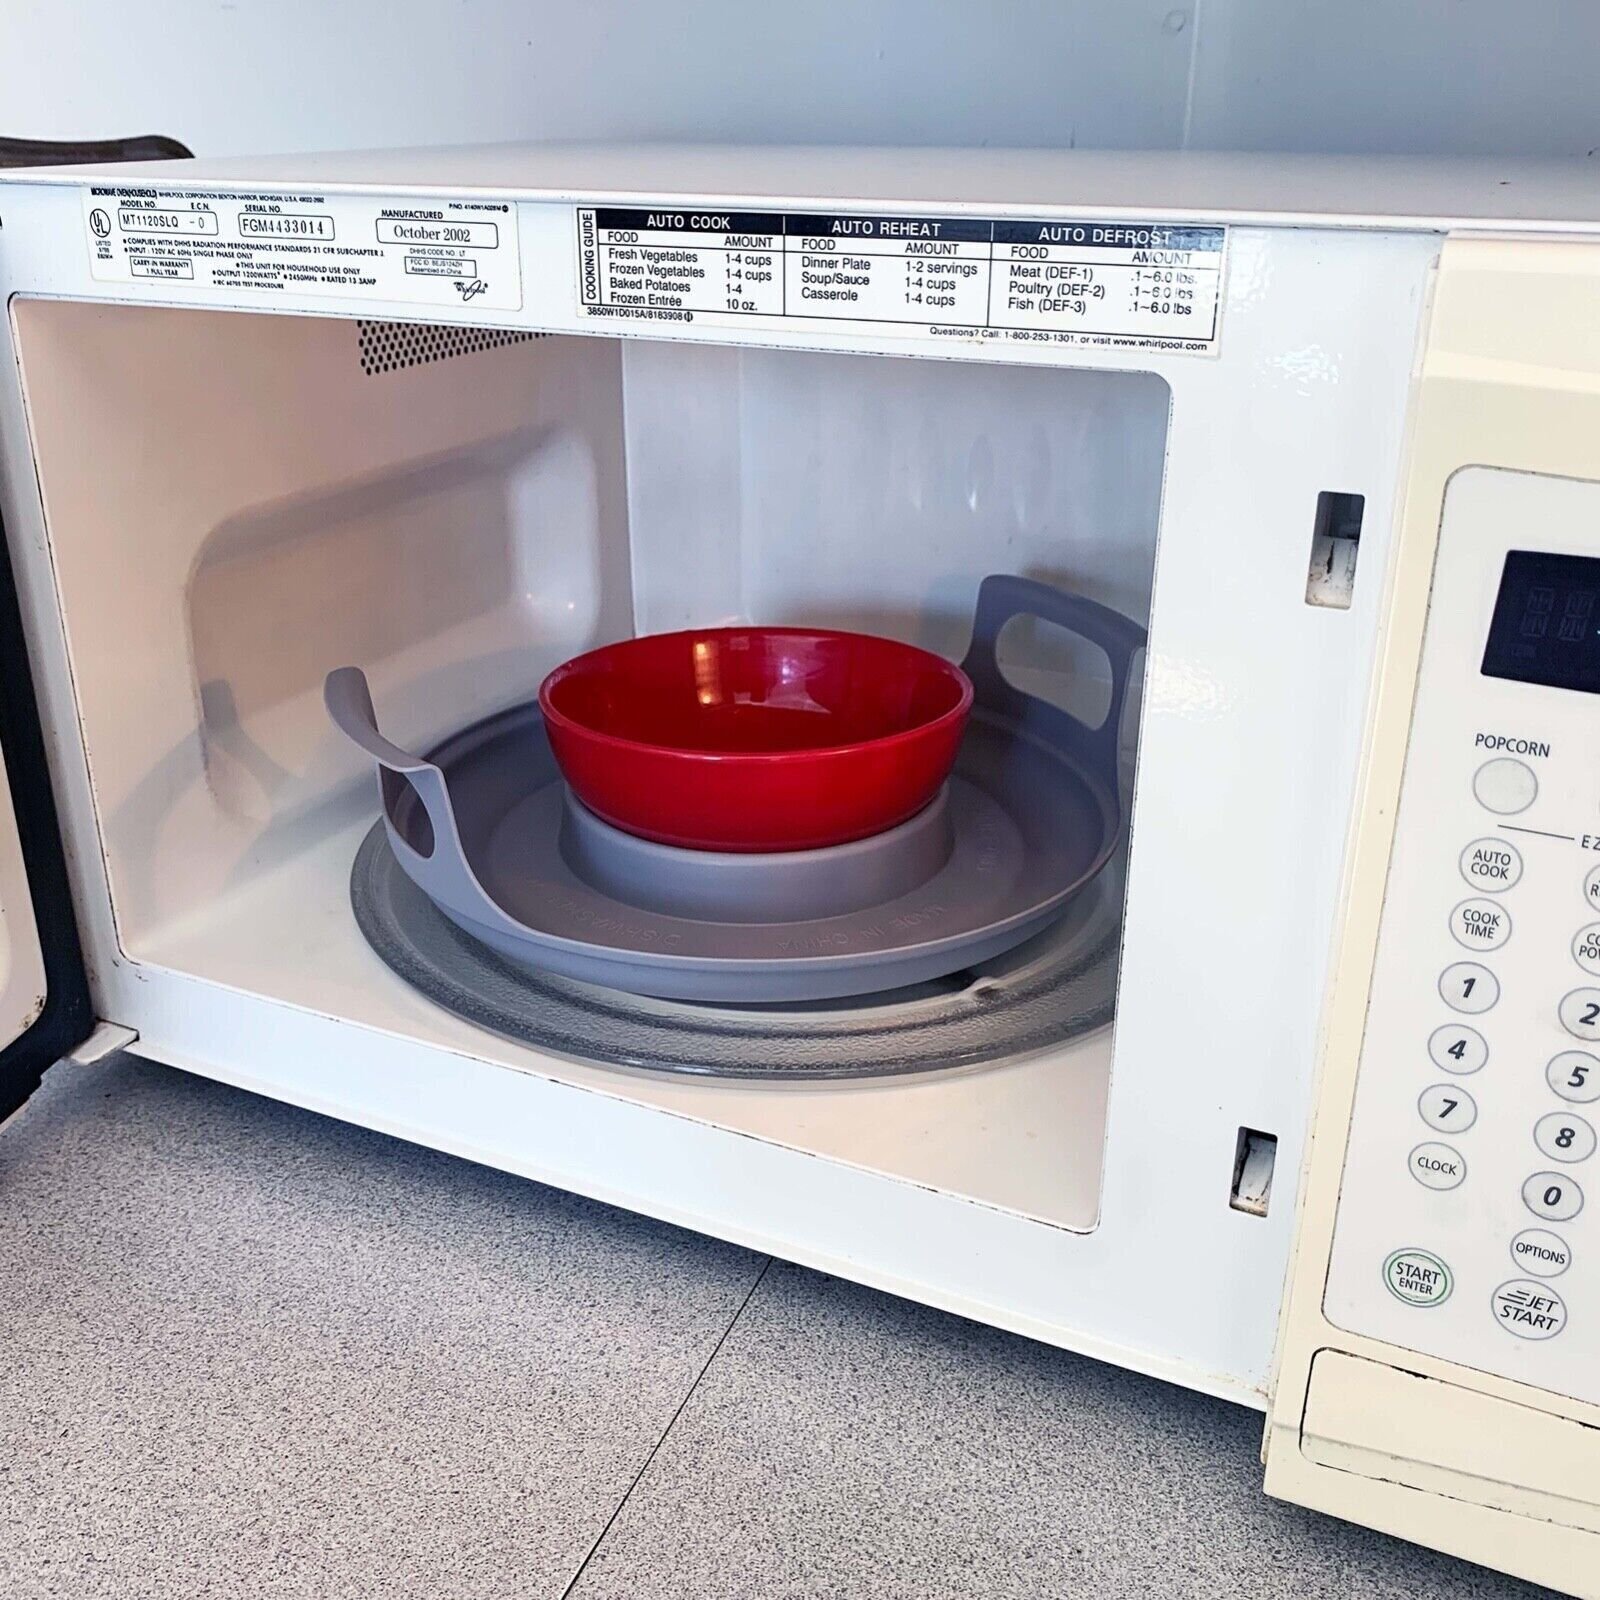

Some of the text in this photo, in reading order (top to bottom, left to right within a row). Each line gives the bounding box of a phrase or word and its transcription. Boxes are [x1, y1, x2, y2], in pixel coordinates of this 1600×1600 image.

[120, 200, 142, 208] MODEL
[245, 204, 267, 212] SERIAL
[122, 214, 178, 228] MT1120SLQ
[381, 210, 443, 219] MANUFACTURED
[647, 214, 731, 230] AUTO COOK
[243, 219, 323, 234] FGM4433014
[394, 225, 470, 242] October 2002
[832, 220, 942, 237] AUTO REHEAT
[607, 231, 639, 243] FOOD
[724, 235, 773, 248] AMOUNT
[801, 238, 836, 251] FOOD
[1038, 227, 1172, 246] AUTO DEFROST
[128, 238, 156, 246] COMPLIES
[227, 242, 272, 251] PERFORMANCE
[274, 244, 311, 253] STANDARDS
[336, 248, 378, 256] SUBCHAPTER
[905, 242, 959, 256] AMOUNT
[1011, 246, 1048, 259] FOOD
[582, 213, 596, 300] COOKING GUIDE
[608, 248, 772, 268] Fresh Vegetables 1-4 cups
[1132, 251, 1193, 265] AMOUNT
[272, 263, 285, 271] FOR
[287, 264, 327, 273] HOUSEHOLD
[329, 266, 340, 274] USE
[343, 267, 361, 275] ONLY
[609, 262, 772, 283] Frozen Vegetables 1-4 cups
[801, 256, 978, 278] Dinner Plate 1-2 servings
[1010, 265, 1041, 278] Meat
[1045, 266, 1093, 282] (DEF-1)
[217, 270, 241, 278] OUTPUT
[326, 276, 347, 284] RATED
[610, 277, 742, 294] Baked Potatoes 1-4
[801, 272, 956, 292] Soup/Sauce 1-4 cups
[801, 287, 955, 308] Casserole 1-4 cups
[1009, 281, 1052, 297] Poultry
[1057, 283, 1105, 299] (DEF-2)
[611, 292, 758, 311] Frozen Entrée 10 oz.
[1008, 297, 1034, 310] Fish
[1038, 299, 1086, 315] (DEF-3)
[587, 306, 683, 321] 3850W1D015A/8183908
[930, 326, 979, 337] Questions?
[981, 330, 1001, 338] Call:
[1092, 336, 1111, 345] visit
[1113, 338, 1207, 351] www.whirlpool.com
[1475, 733, 1550, 758] POPCORN
[1473, 848, 1511, 866] AUTO
[1471, 862, 1509, 880] COOK
[1463, 909, 1500, 927] COOK
[1464, 922, 1495, 939] TIME
[1462, 978, 1476, 998] 1
[1578, 1003, 1600, 1025] 2
[1447, 1039, 1467, 1060] 4
[1568, 1065, 1589, 1088] 5
[1437, 1098, 1458, 1119] 7
[1555, 1127, 1576, 1148] 8
[1417, 1156, 1457, 1176] CLOCK
[1543, 1186, 1562, 1206] 0
[1515, 1242, 1566, 1265] OPTIONS
[1395, 1261, 1442, 1286] START
[1398, 1277, 1433, 1295] ENTER
[1524, 1295, 1559, 1313] JET
[1500, 1304, 1559, 1332] START
